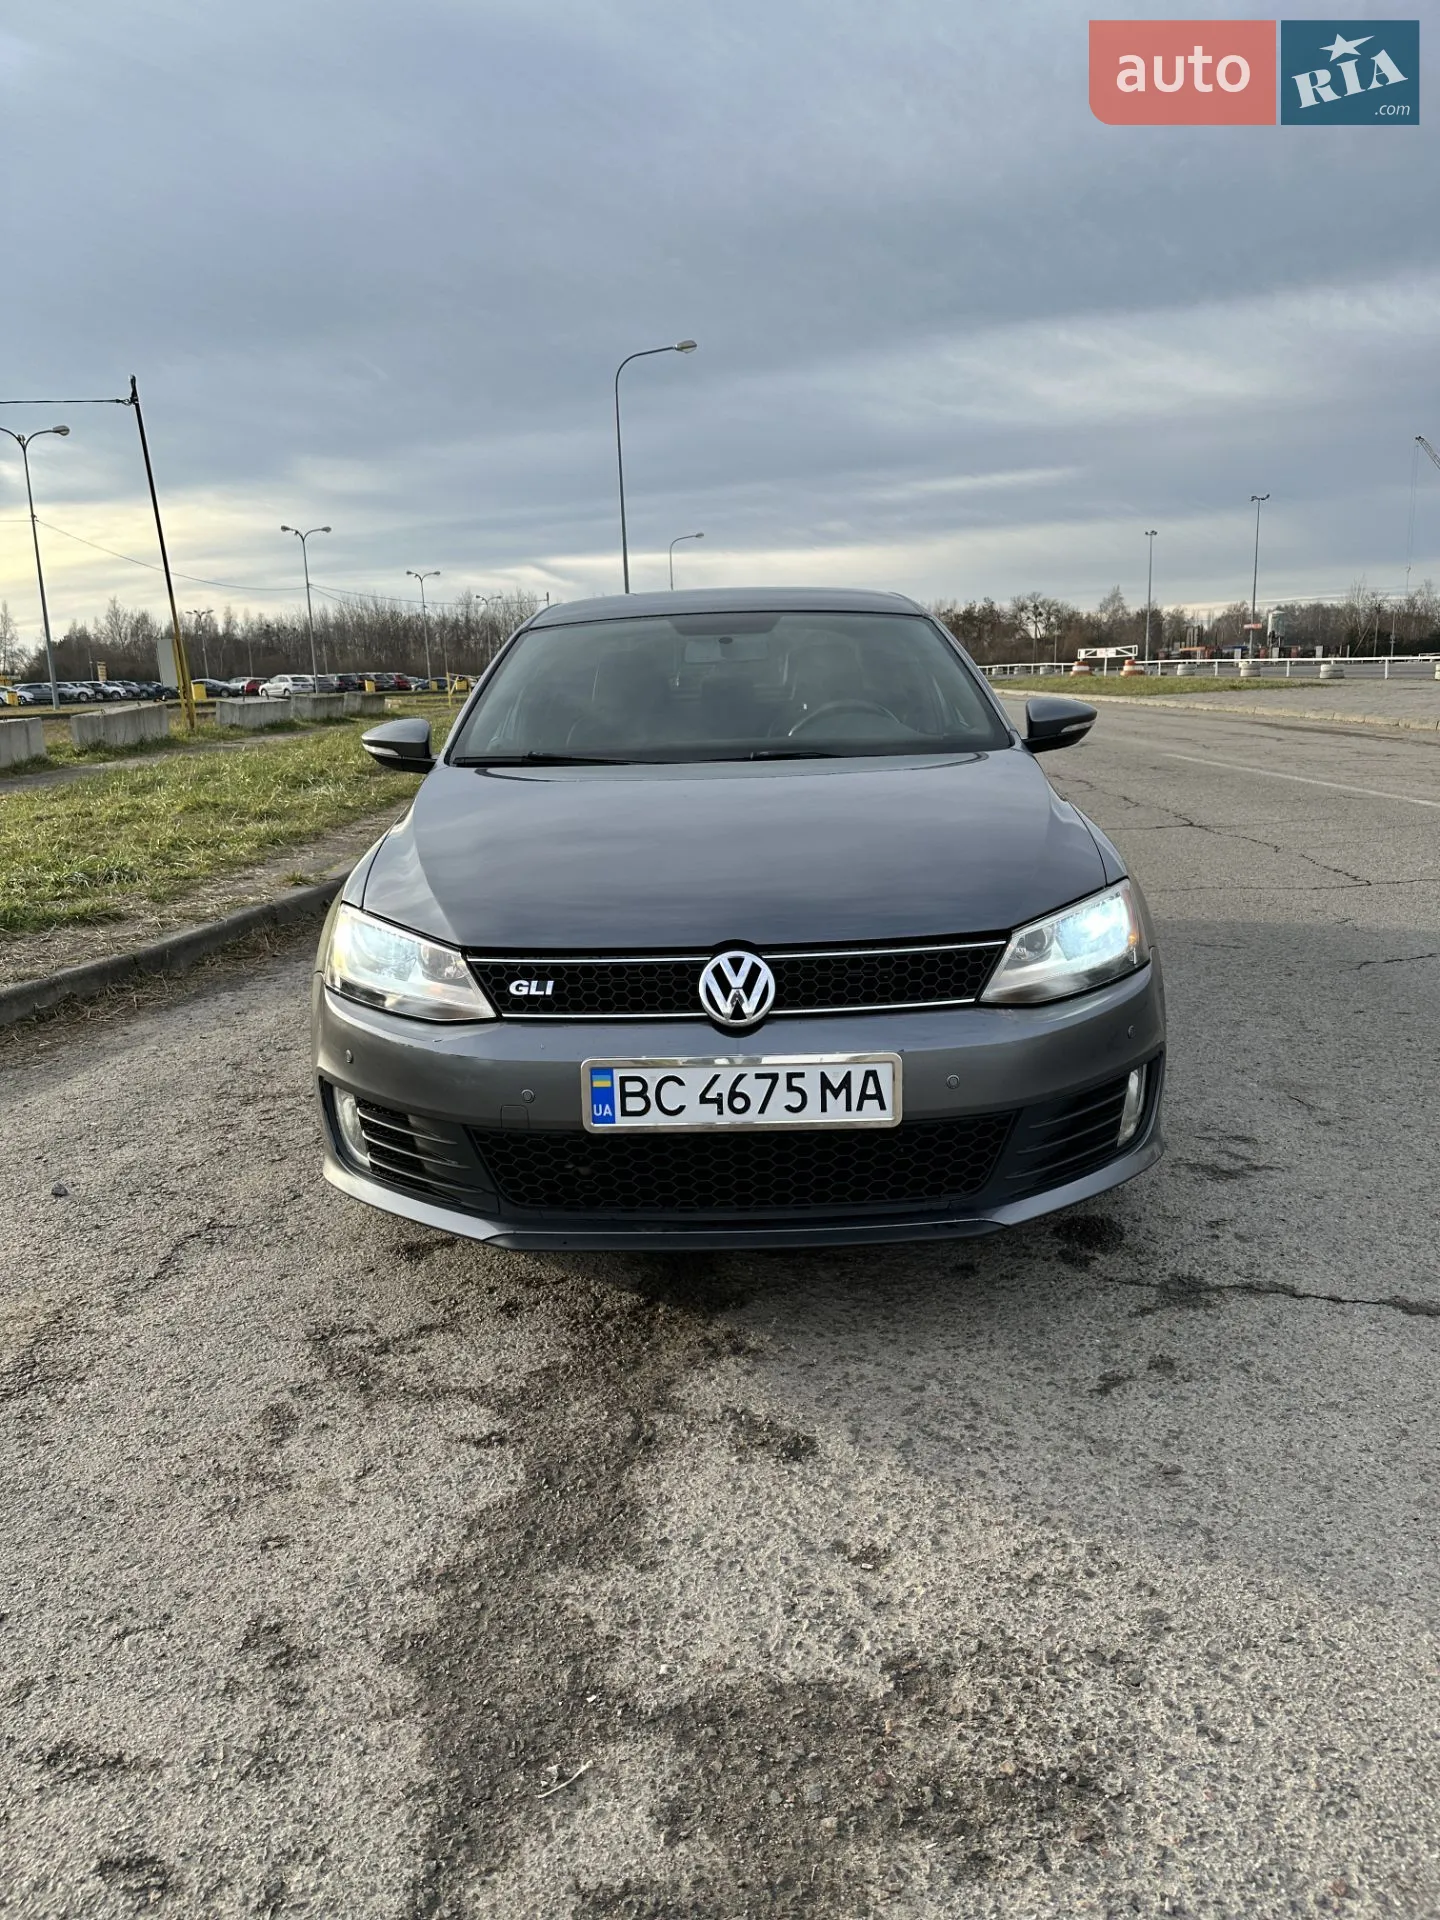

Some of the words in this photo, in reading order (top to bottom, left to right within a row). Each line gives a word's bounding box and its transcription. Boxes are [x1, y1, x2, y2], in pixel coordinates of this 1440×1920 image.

[508, 980, 554, 996] GLI
[618, 1075, 686, 1117] BC
[699, 1073, 808, 1116] 4675
[820, 1069, 887, 1113] MA
[593, 1105, 613, 1117] UA
